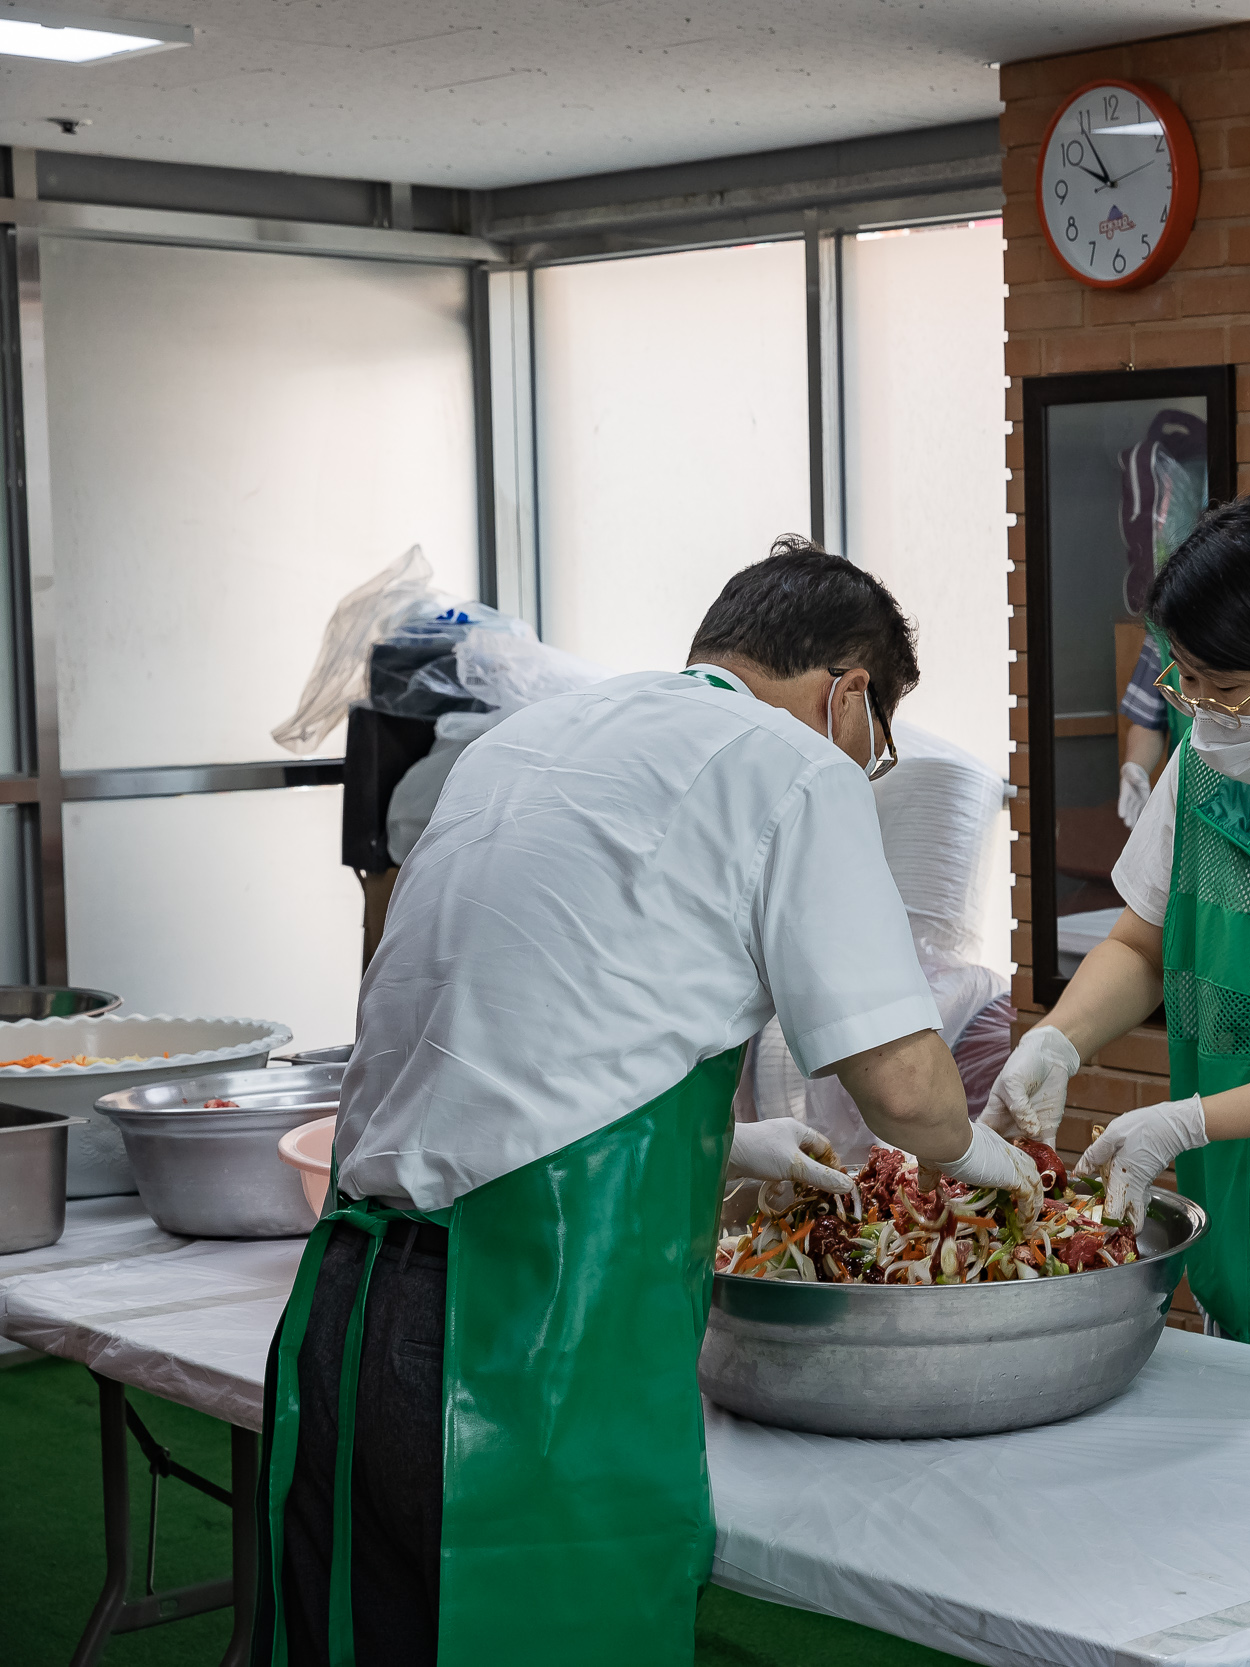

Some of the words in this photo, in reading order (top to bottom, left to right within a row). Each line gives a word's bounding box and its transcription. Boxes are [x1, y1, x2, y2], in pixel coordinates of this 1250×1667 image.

[1103, 94, 1119, 121] 12
[1078, 109, 1091, 134] 11
[1061, 139, 1084, 168] 10
[1055, 179, 1068, 205] 9
[1065, 216, 1078, 242] 8
[1088, 241, 1096, 266] 7
[1141, 234, 1151, 260] 5
[1112, 248, 1126, 273] 6
